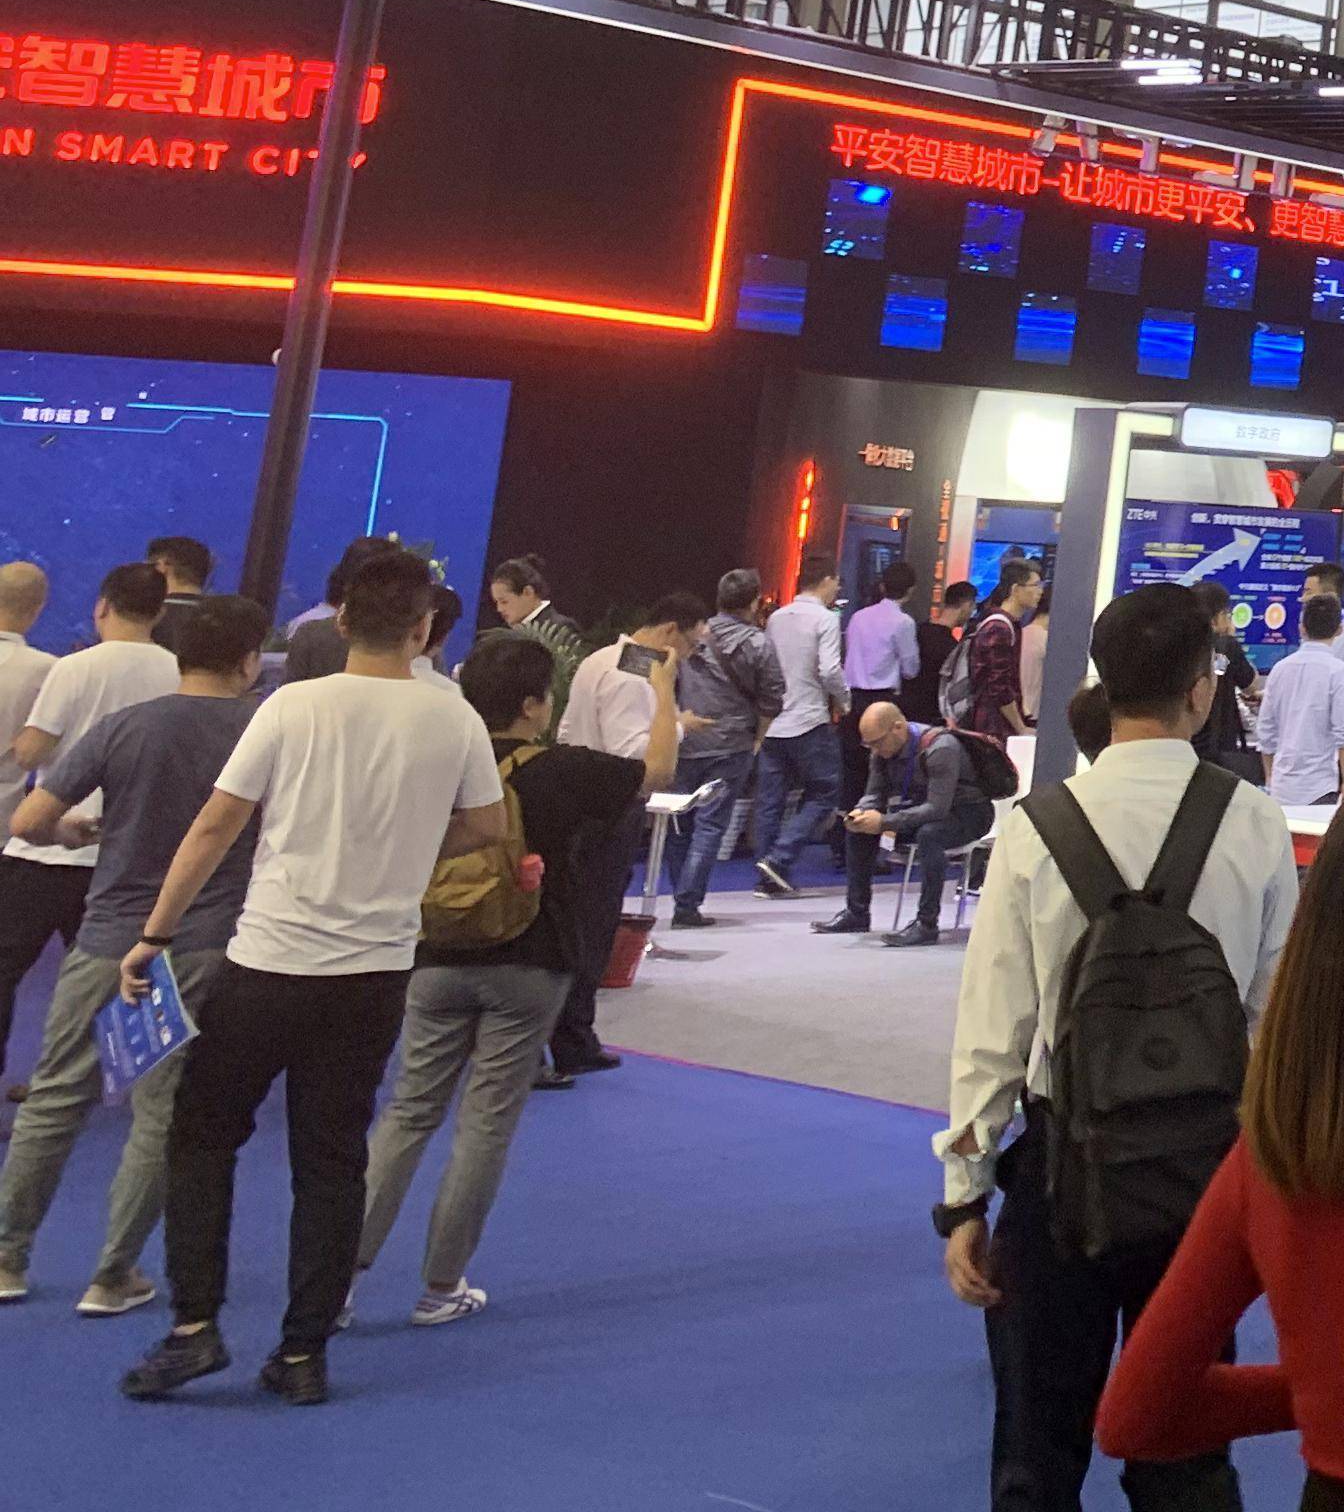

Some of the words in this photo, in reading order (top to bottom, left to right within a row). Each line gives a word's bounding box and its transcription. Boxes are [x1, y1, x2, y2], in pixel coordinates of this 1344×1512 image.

[0, 33, 387, 125] 智慧城市
[0, 128, 34, 156] N
[57, 130, 229, 171] SMART
